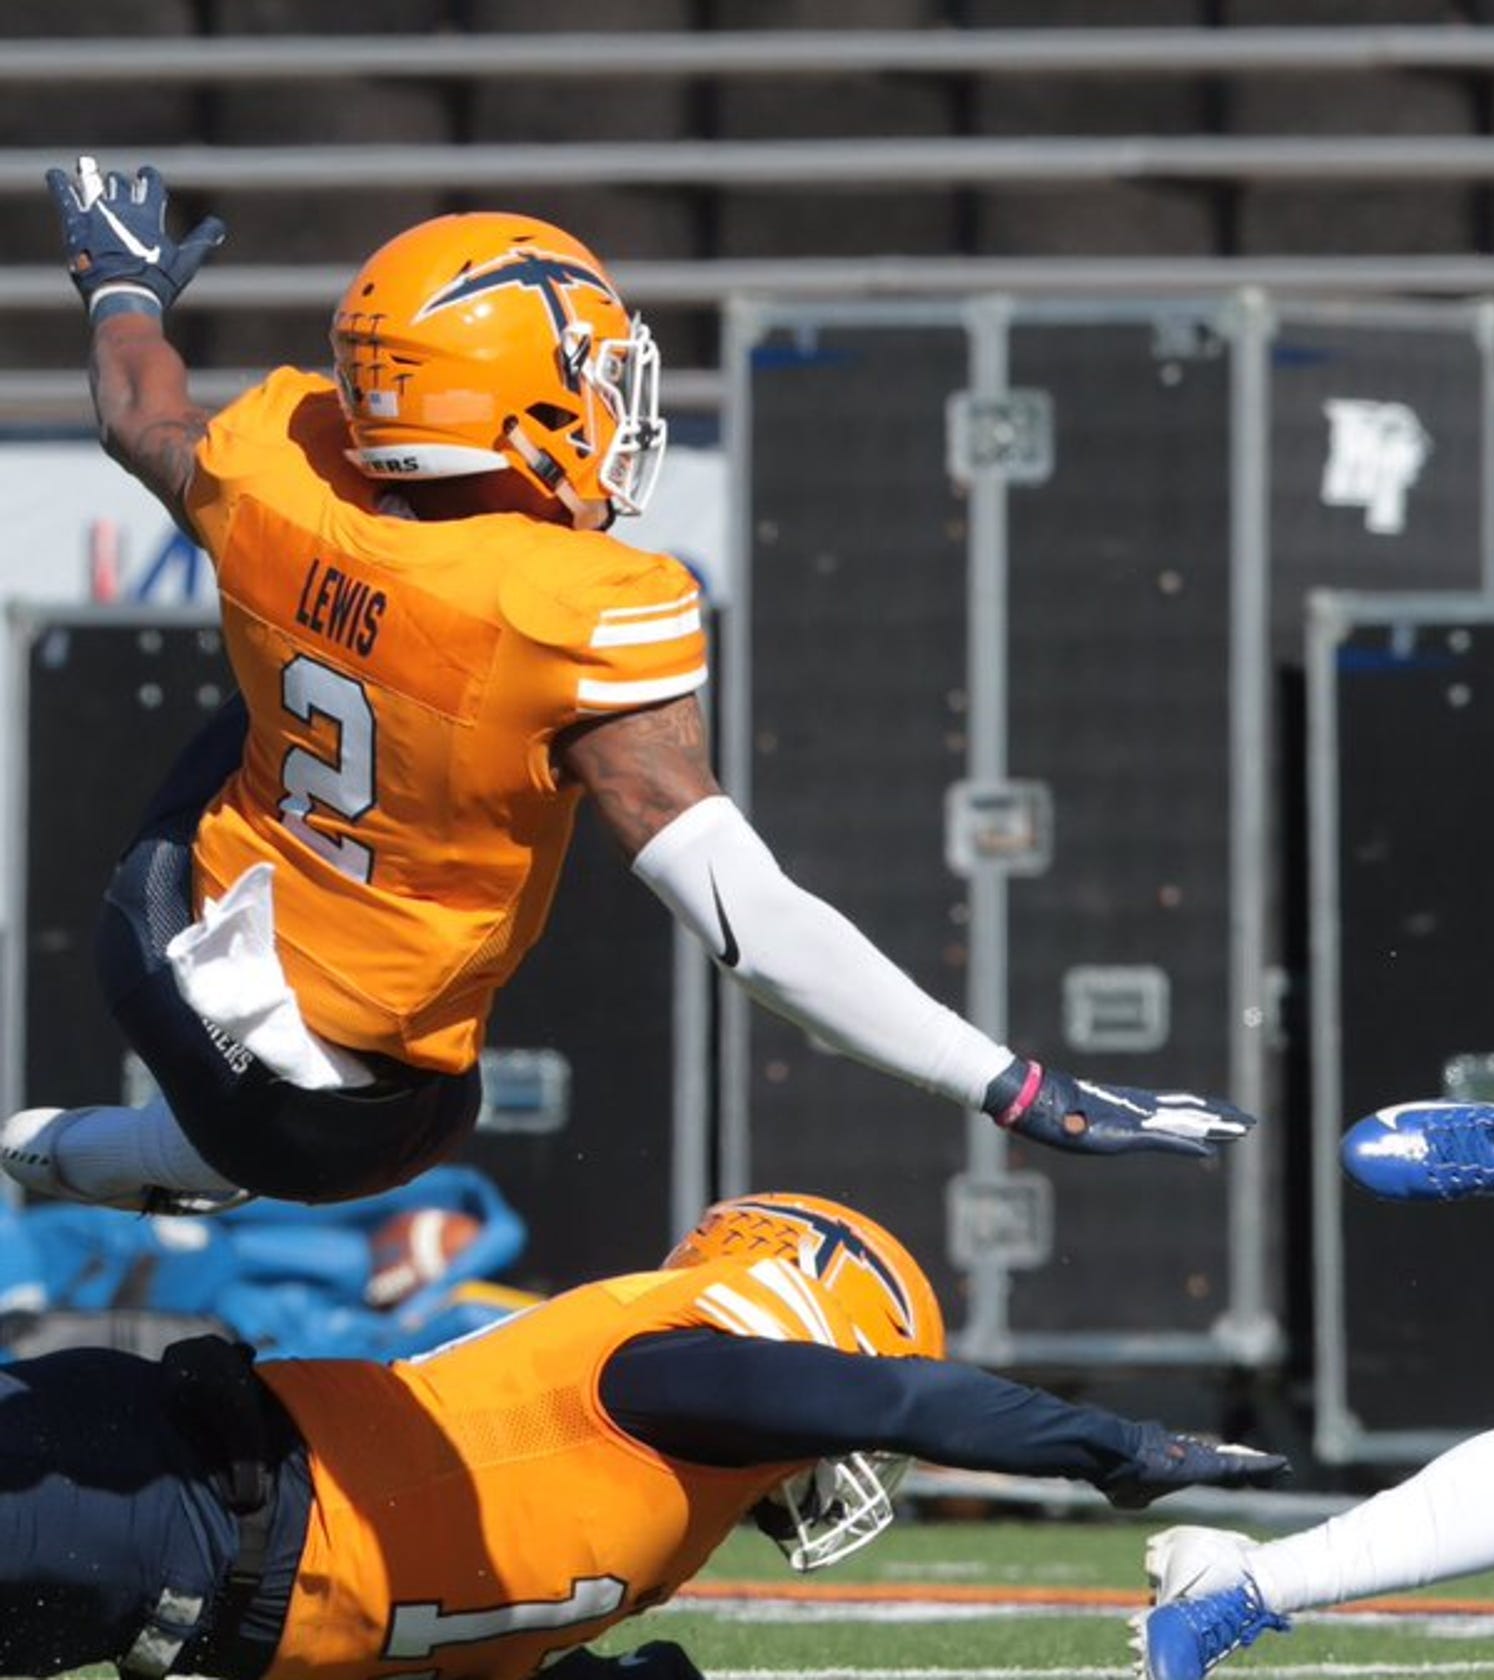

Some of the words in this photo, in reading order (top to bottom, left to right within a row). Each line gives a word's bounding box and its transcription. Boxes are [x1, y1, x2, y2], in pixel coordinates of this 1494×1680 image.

[366, 456, 419, 472] ERS
[295, 558, 388, 658] LEWIS
[279, 652, 377, 885] 2
[377, 1574, 628, 1680] 1
